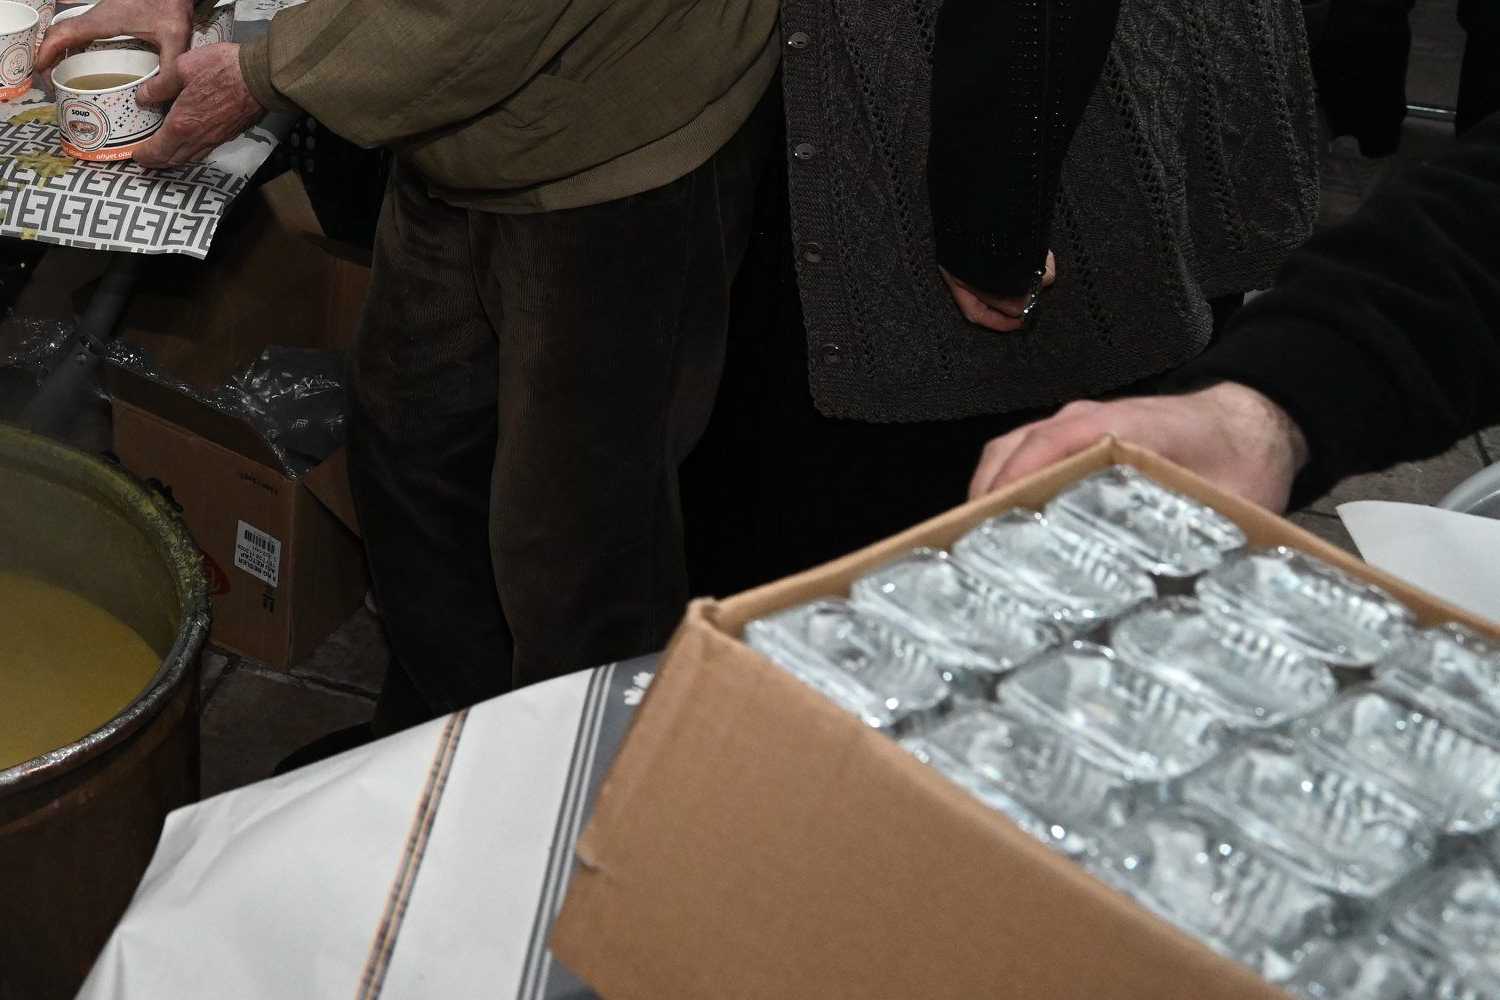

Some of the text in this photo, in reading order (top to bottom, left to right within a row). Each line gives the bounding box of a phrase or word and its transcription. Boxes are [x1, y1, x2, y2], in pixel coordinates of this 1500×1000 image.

[71, 109, 90, 117] soup
[118, 150, 132, 158] olsu
[238, 557, 261, 574] BESLER
[240, 551, 264, 568] KETÇAP
